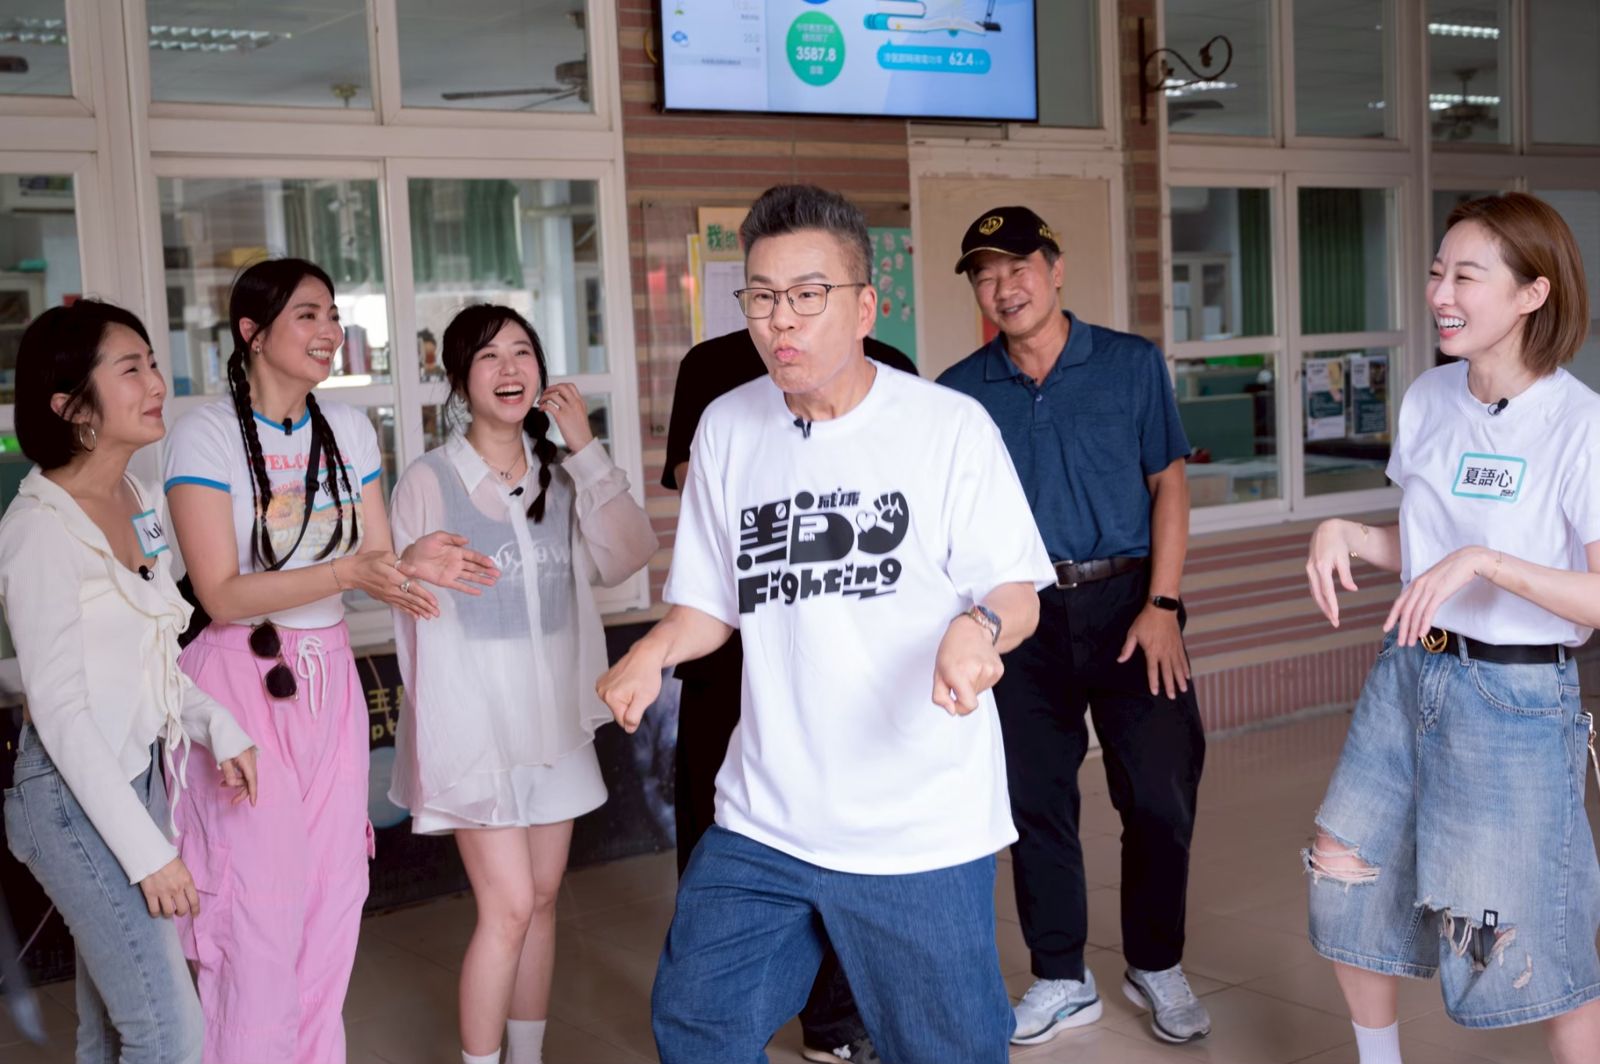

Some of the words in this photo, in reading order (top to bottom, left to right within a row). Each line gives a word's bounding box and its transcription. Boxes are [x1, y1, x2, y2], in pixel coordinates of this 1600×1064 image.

[796, 46, 837, 62] 3587.8
[949, 51, 974, 66] 62.4
[1462, 467, 1513, 488] 夏語心
[738, 558, 902, 615] Fighting
